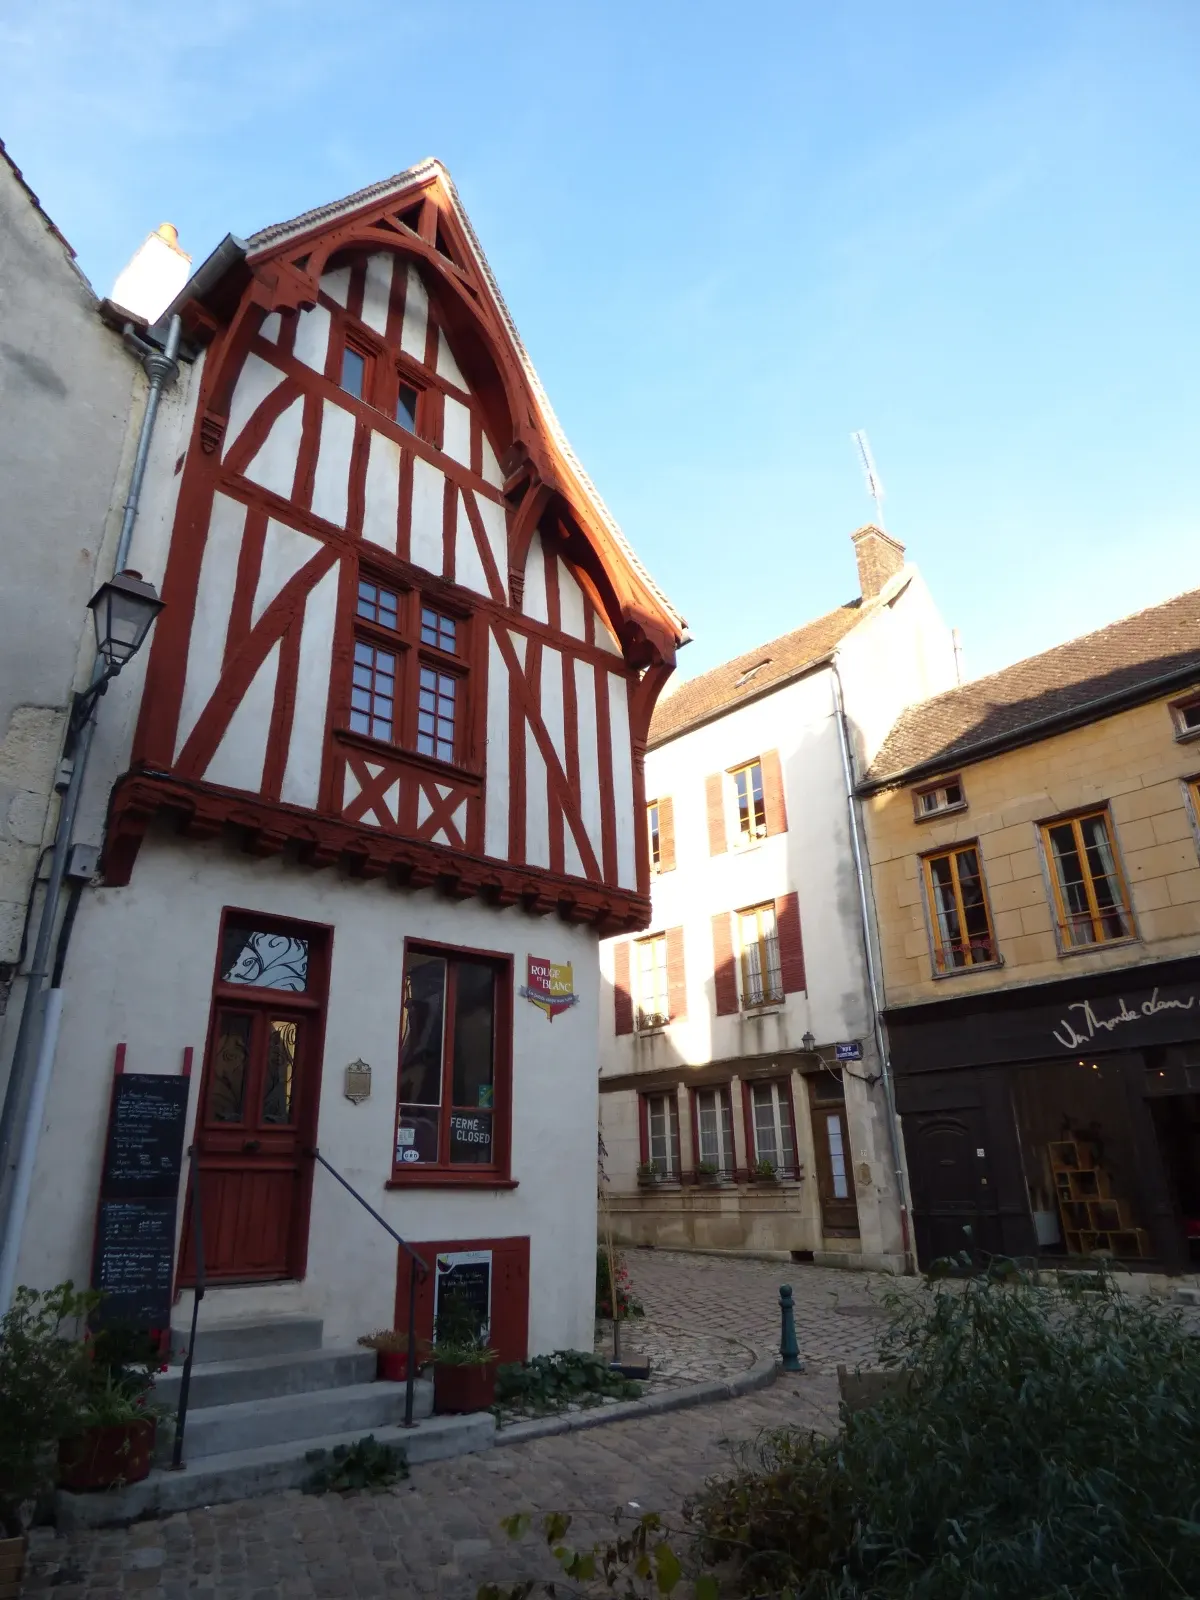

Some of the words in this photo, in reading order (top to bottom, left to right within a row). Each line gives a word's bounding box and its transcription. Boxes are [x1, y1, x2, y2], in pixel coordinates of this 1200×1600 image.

[531, 965, 560, 978] ROUGE
[542, 979, 571, 992] BLANC
[456, 1130, 490, 1144] CLOSED
